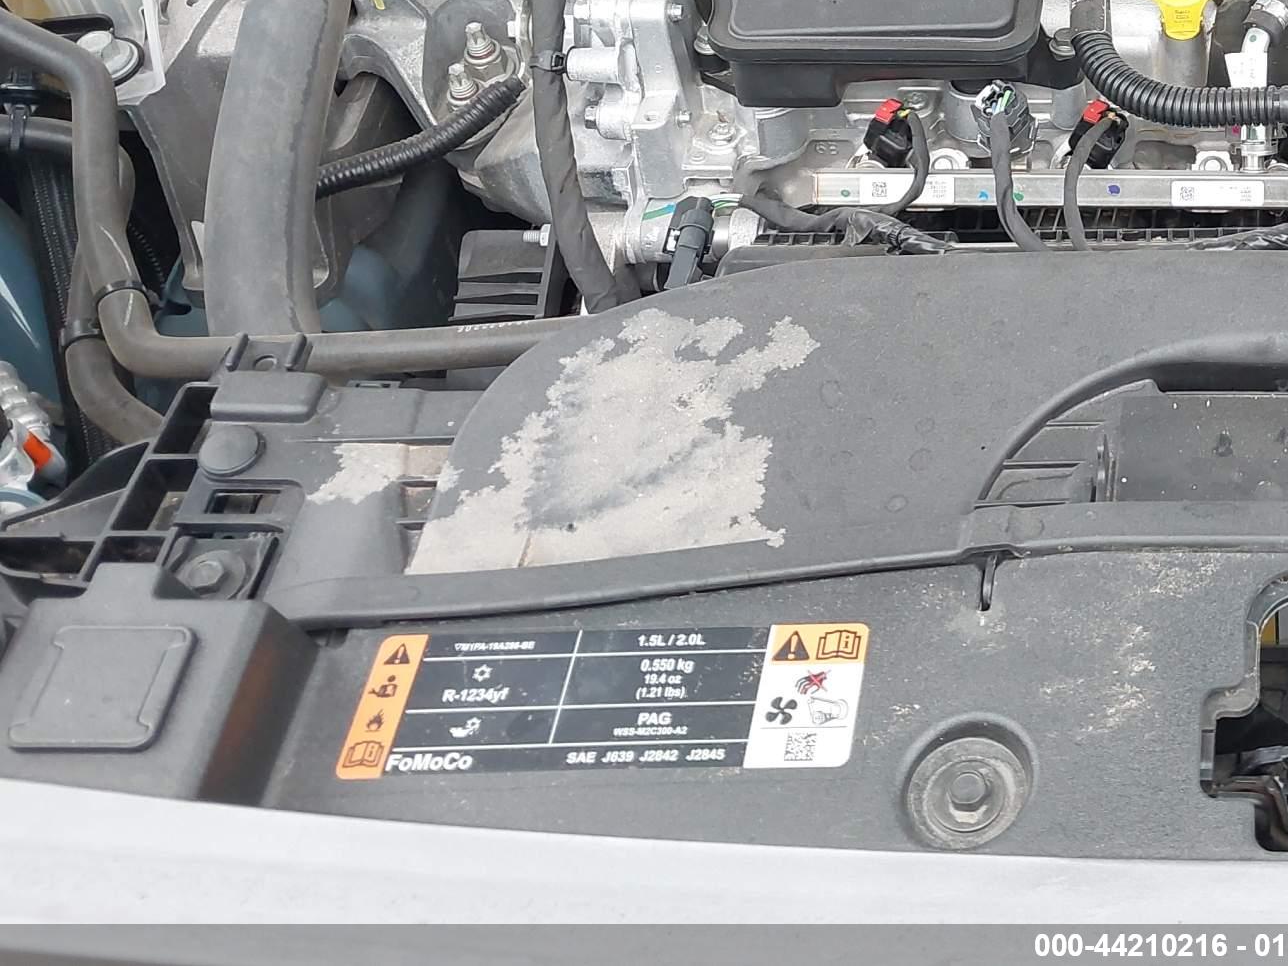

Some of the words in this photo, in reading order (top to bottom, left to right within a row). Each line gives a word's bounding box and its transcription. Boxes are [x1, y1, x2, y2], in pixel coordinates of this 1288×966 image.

[637, 634, 666, 647] 1.5L
[667, 635, 675, 647] /
[675, 633, 706, 646] 2.0L
[640, 659, 676, 672] 0.550
[676, 658, 695, 674] kg
[644, 673, 667, 685] 19.4
[667, 675, 683, 684] oz
[442, 685, 510, 704] R-1234yf
[635, 687, 663, 701] (1.21
[636, 711, 673, 726] PAG
[384, 752, 474, 772] FoMoCo
[566, 751, 597, 764] SAE
[601, 750, 635, 763] J639
[638, 749, 679, 762] J2842
[685, 748, 726, 761] J2845
